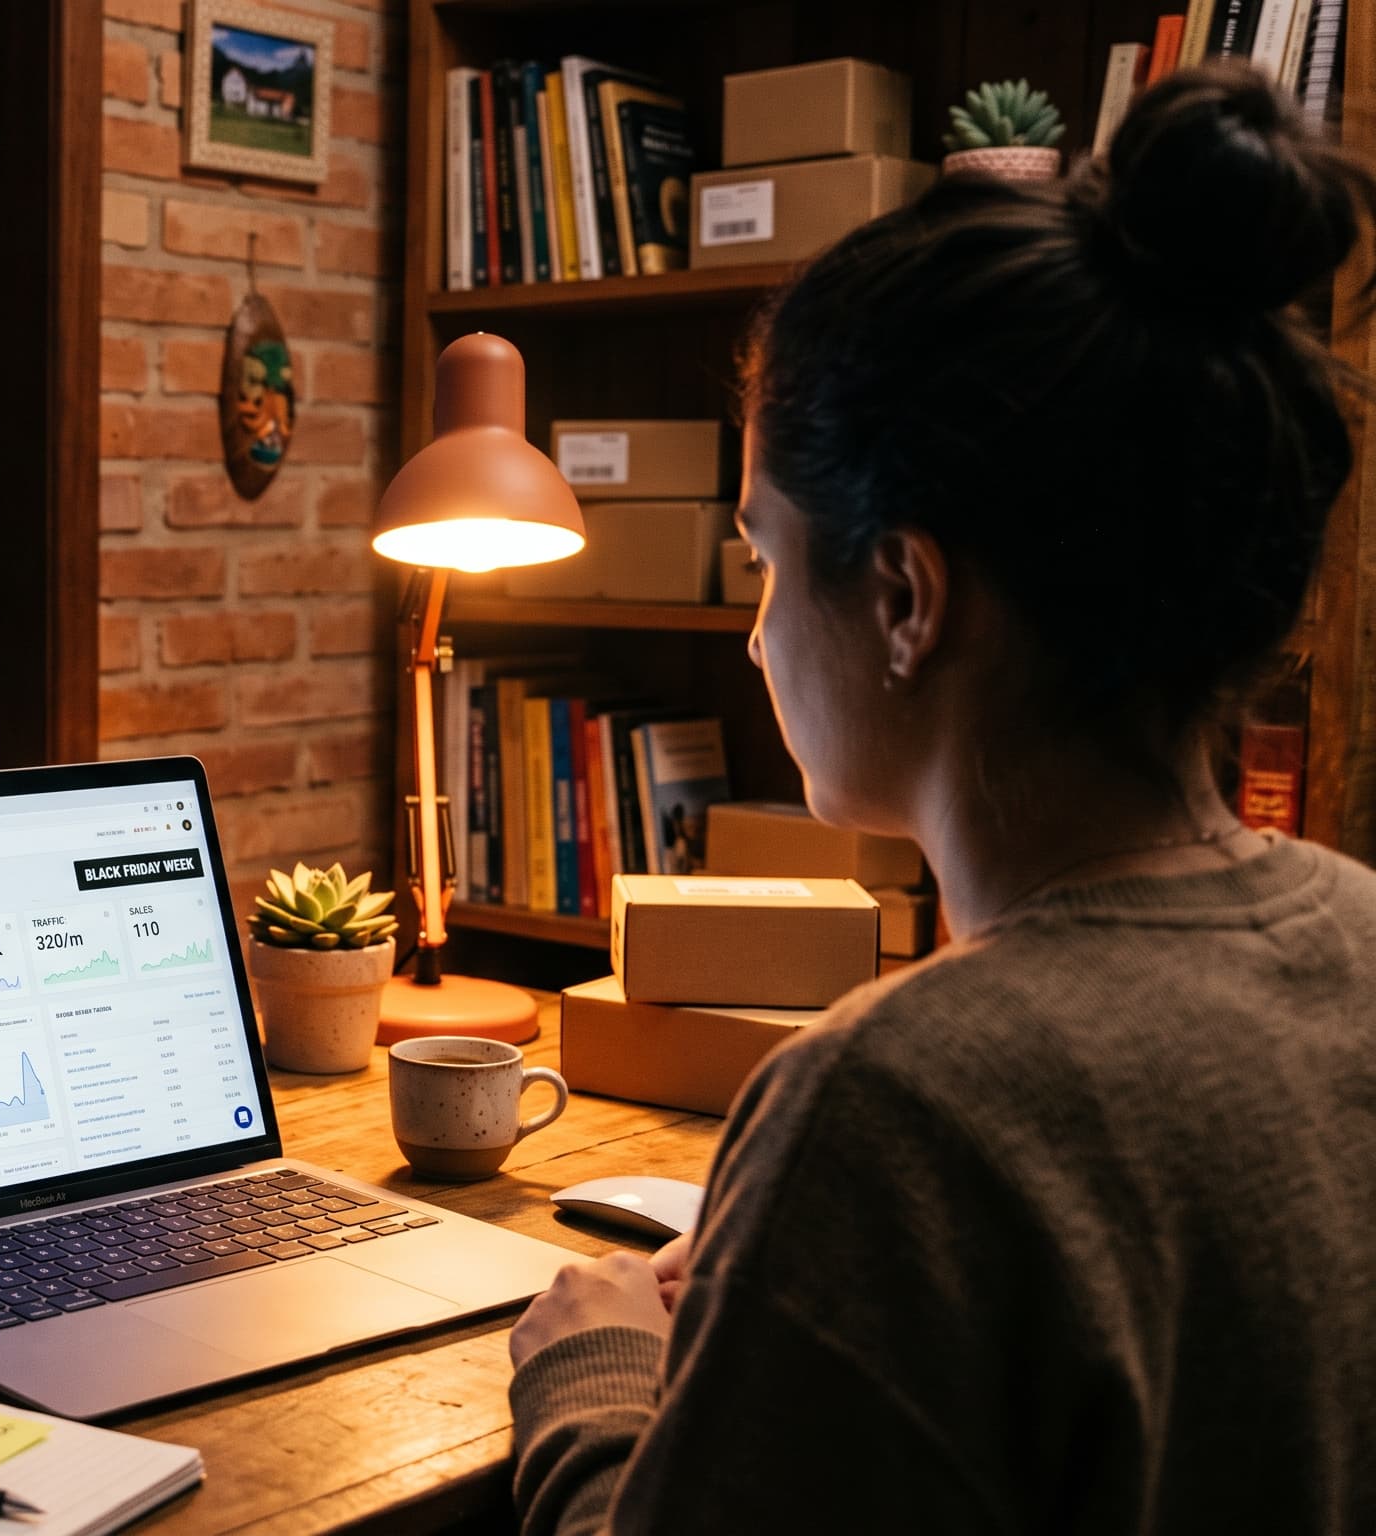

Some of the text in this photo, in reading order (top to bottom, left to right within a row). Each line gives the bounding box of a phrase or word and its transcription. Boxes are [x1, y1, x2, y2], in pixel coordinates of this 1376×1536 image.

[84, 857, 195, 882] BLACK FRIDAY WEEK
[133, 921, 160, 938] 110
[35, 932, 84, 951] 320/m
